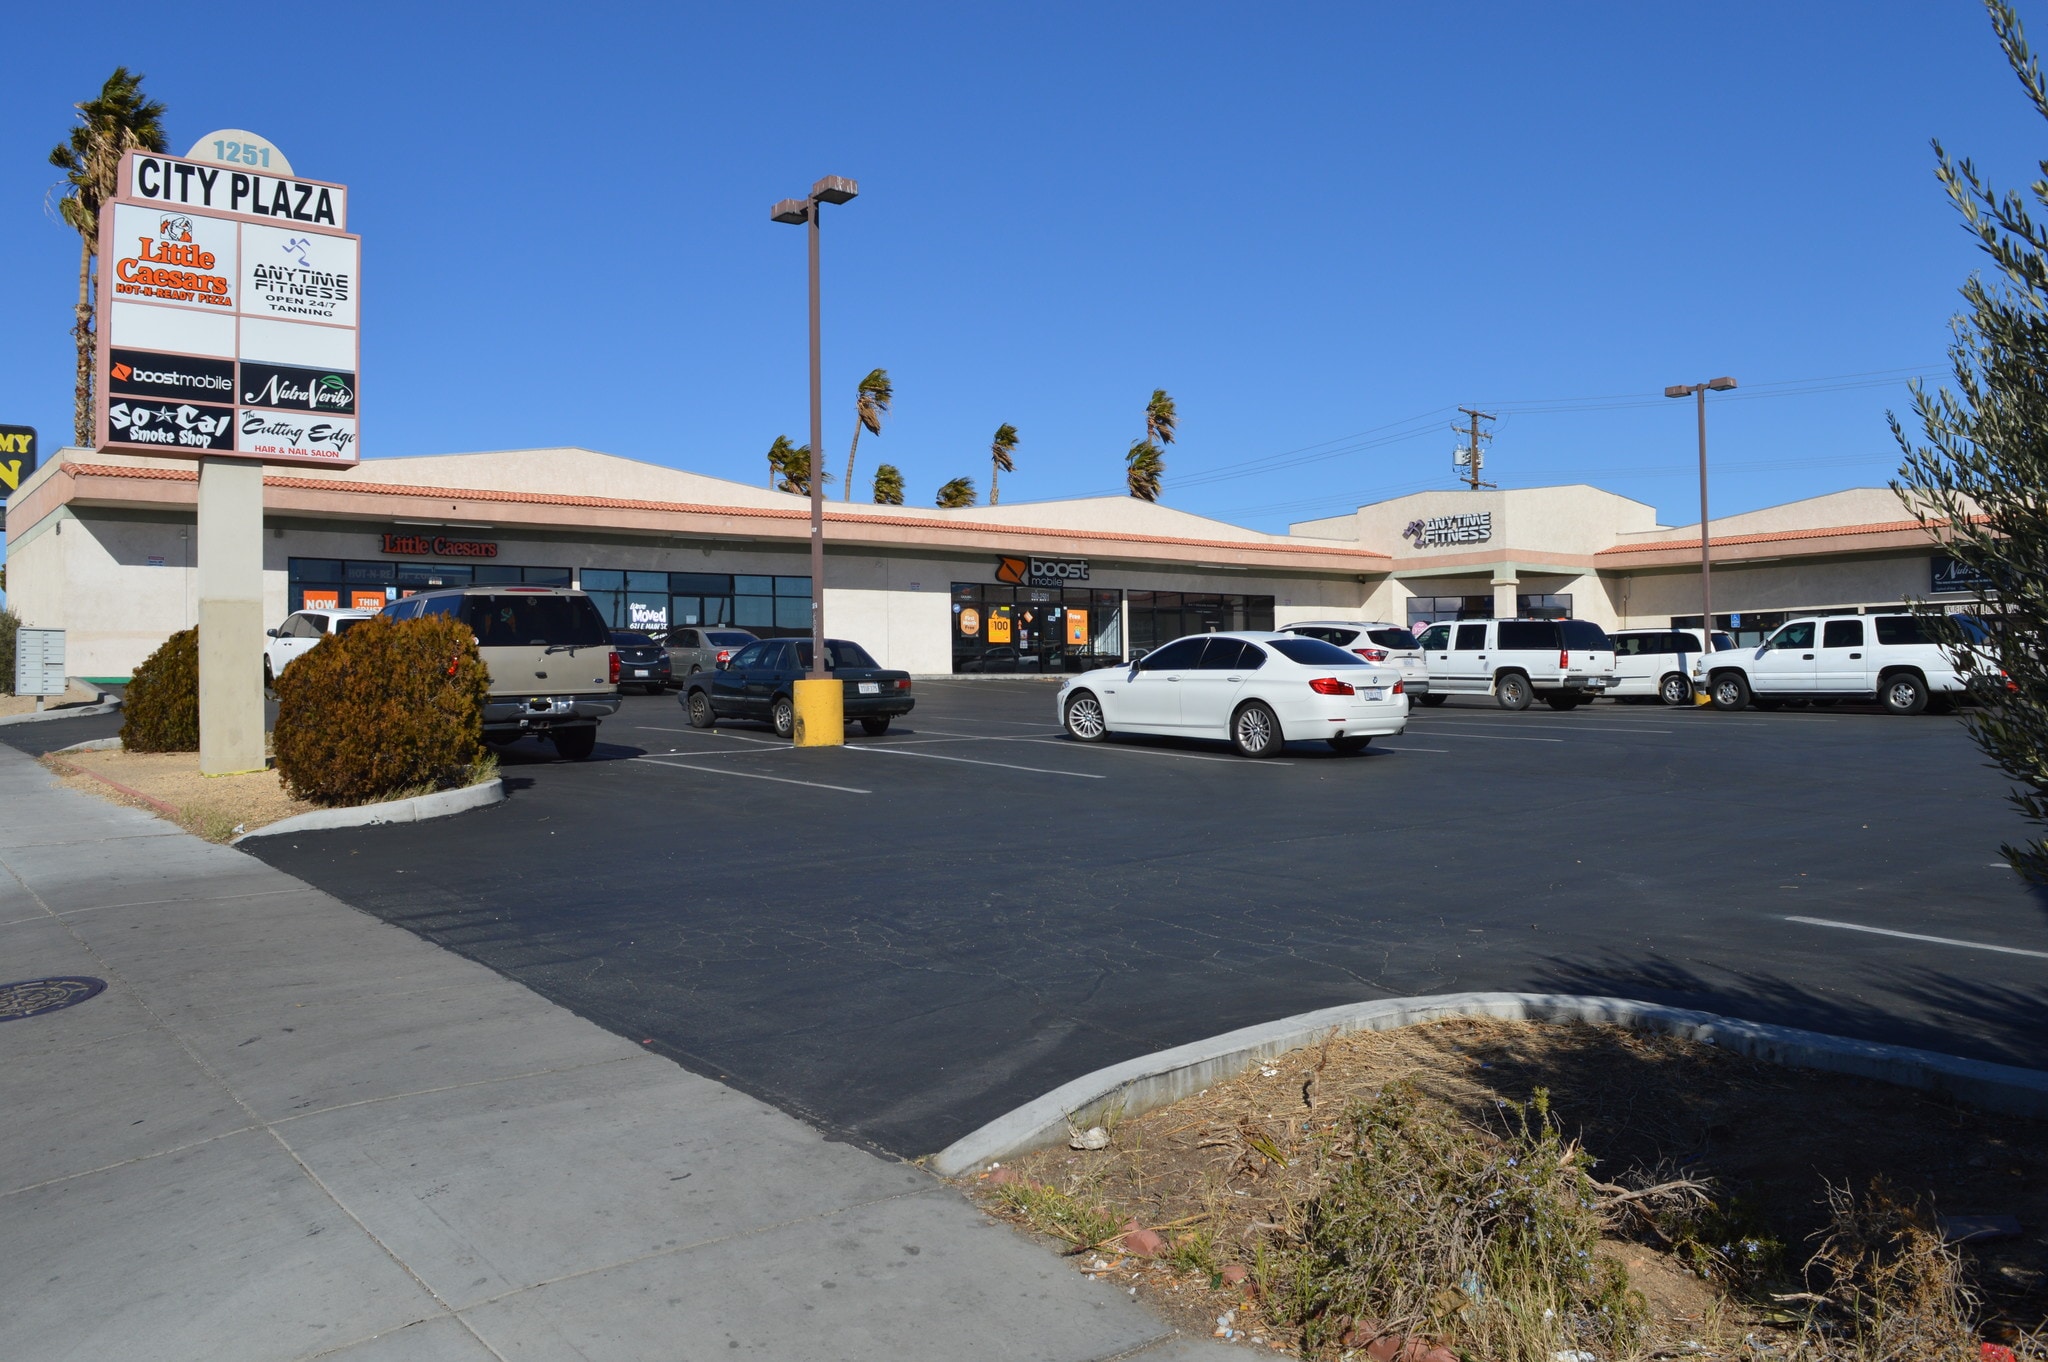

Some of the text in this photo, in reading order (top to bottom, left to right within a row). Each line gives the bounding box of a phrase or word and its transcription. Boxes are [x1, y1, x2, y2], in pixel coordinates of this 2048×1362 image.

[213, 140, 270, 168] 1251
[138, 158, 336, 225] CITY PLAZA
[138, 237, 216, 270] Little
[116, 258, 228, 295] Caesars
[253, 263, 348, 287] ANYTIME
[116, 283, 233, 306] HOT-N-READY PIZZA
[256, 279, 348, 301] FITNESS
[265, 295, 336, 310] OPEN 24/7
[268, 304, 333, 317] TANNING
[129, 426, 211, 449] Smoke Shop
[242, 417, 355, 451] Cutting Edge
[255, 445, 339, 458] HAIR & NAIL SALON
[1426, 512, 1491, 531] ANYTIME
[383, 534, 497, 557] Little Caesars
[1425, 525, 1491, 544] FITNESS
[1031, 557, 1089, 579] boost
[1031, 577, 1062, 586] mobile
[306, 599, 336, 610] NOW
[358, 598, 379, 606] THIN
[632, 607, 666, 622] Moved
